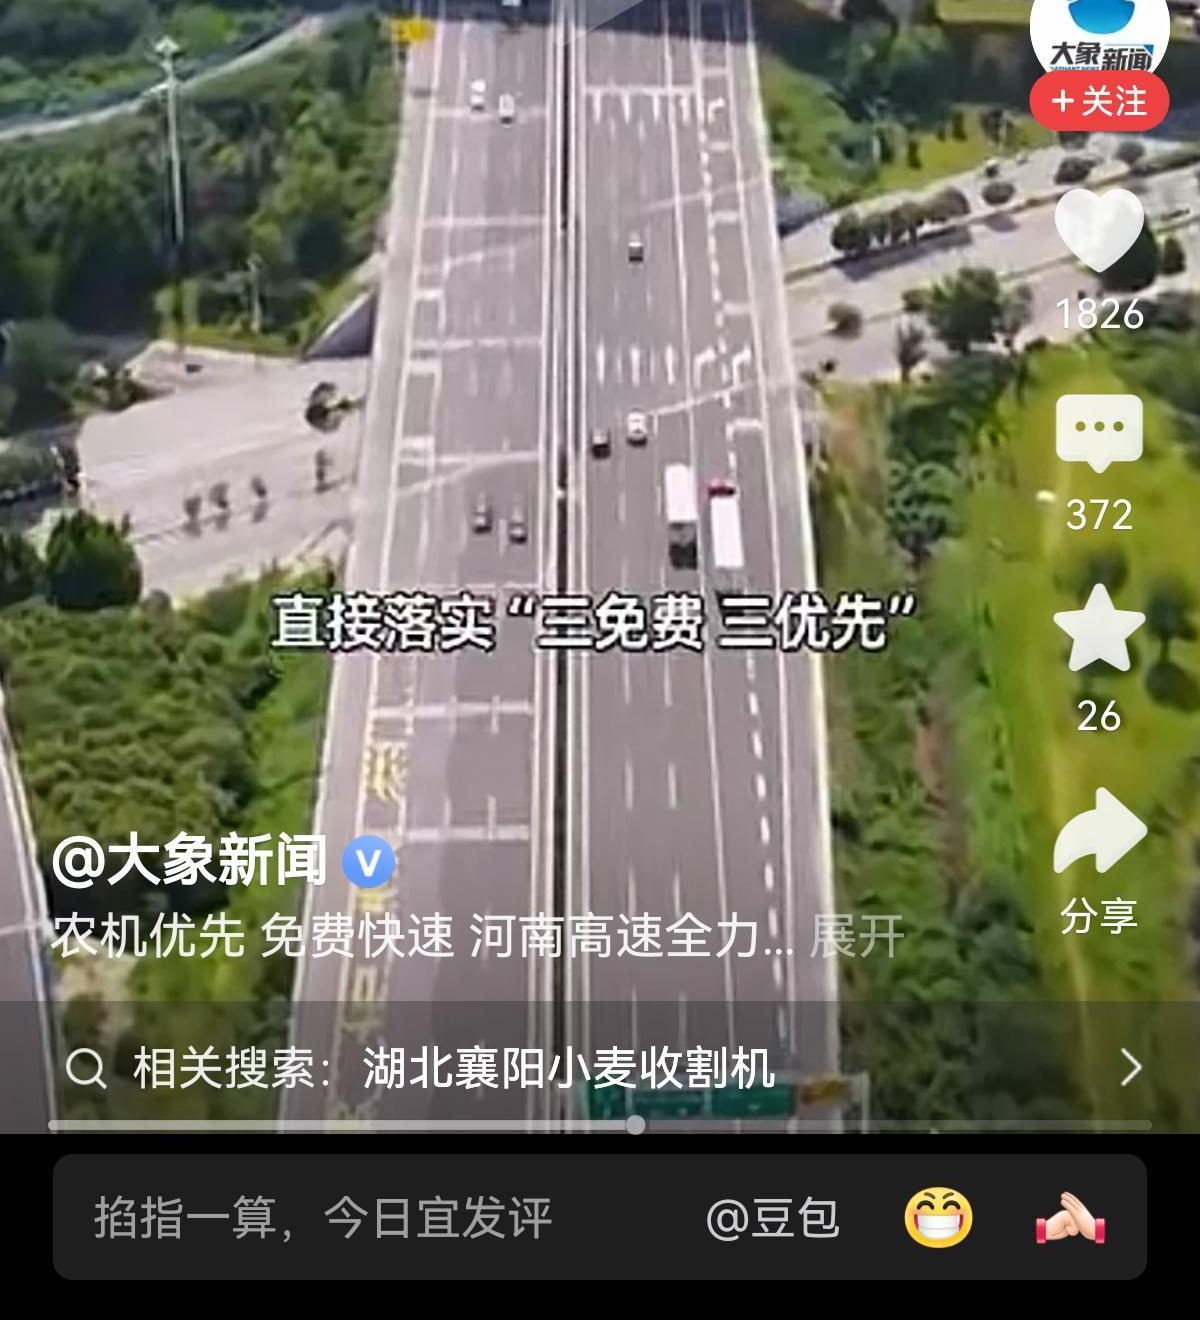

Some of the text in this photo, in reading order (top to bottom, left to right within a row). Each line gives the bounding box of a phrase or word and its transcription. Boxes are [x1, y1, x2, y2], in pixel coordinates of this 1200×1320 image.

[1056, 298, 1144, 329] 1826
[1066, 499, 1133, 530] 372
[1077, 699, 1122, 731] 26
[51, 831, 327, 887] @大象新闻
[51, 911, 246, 959] 农机优先
[261, 911, 455, 959] 免费快速
[1059, 896, 1138, 935] 分享
[362, 1043, 776, 1091] 湖北襄阳小麦收割机
[706, 1194, 841, 1243] @豆包
